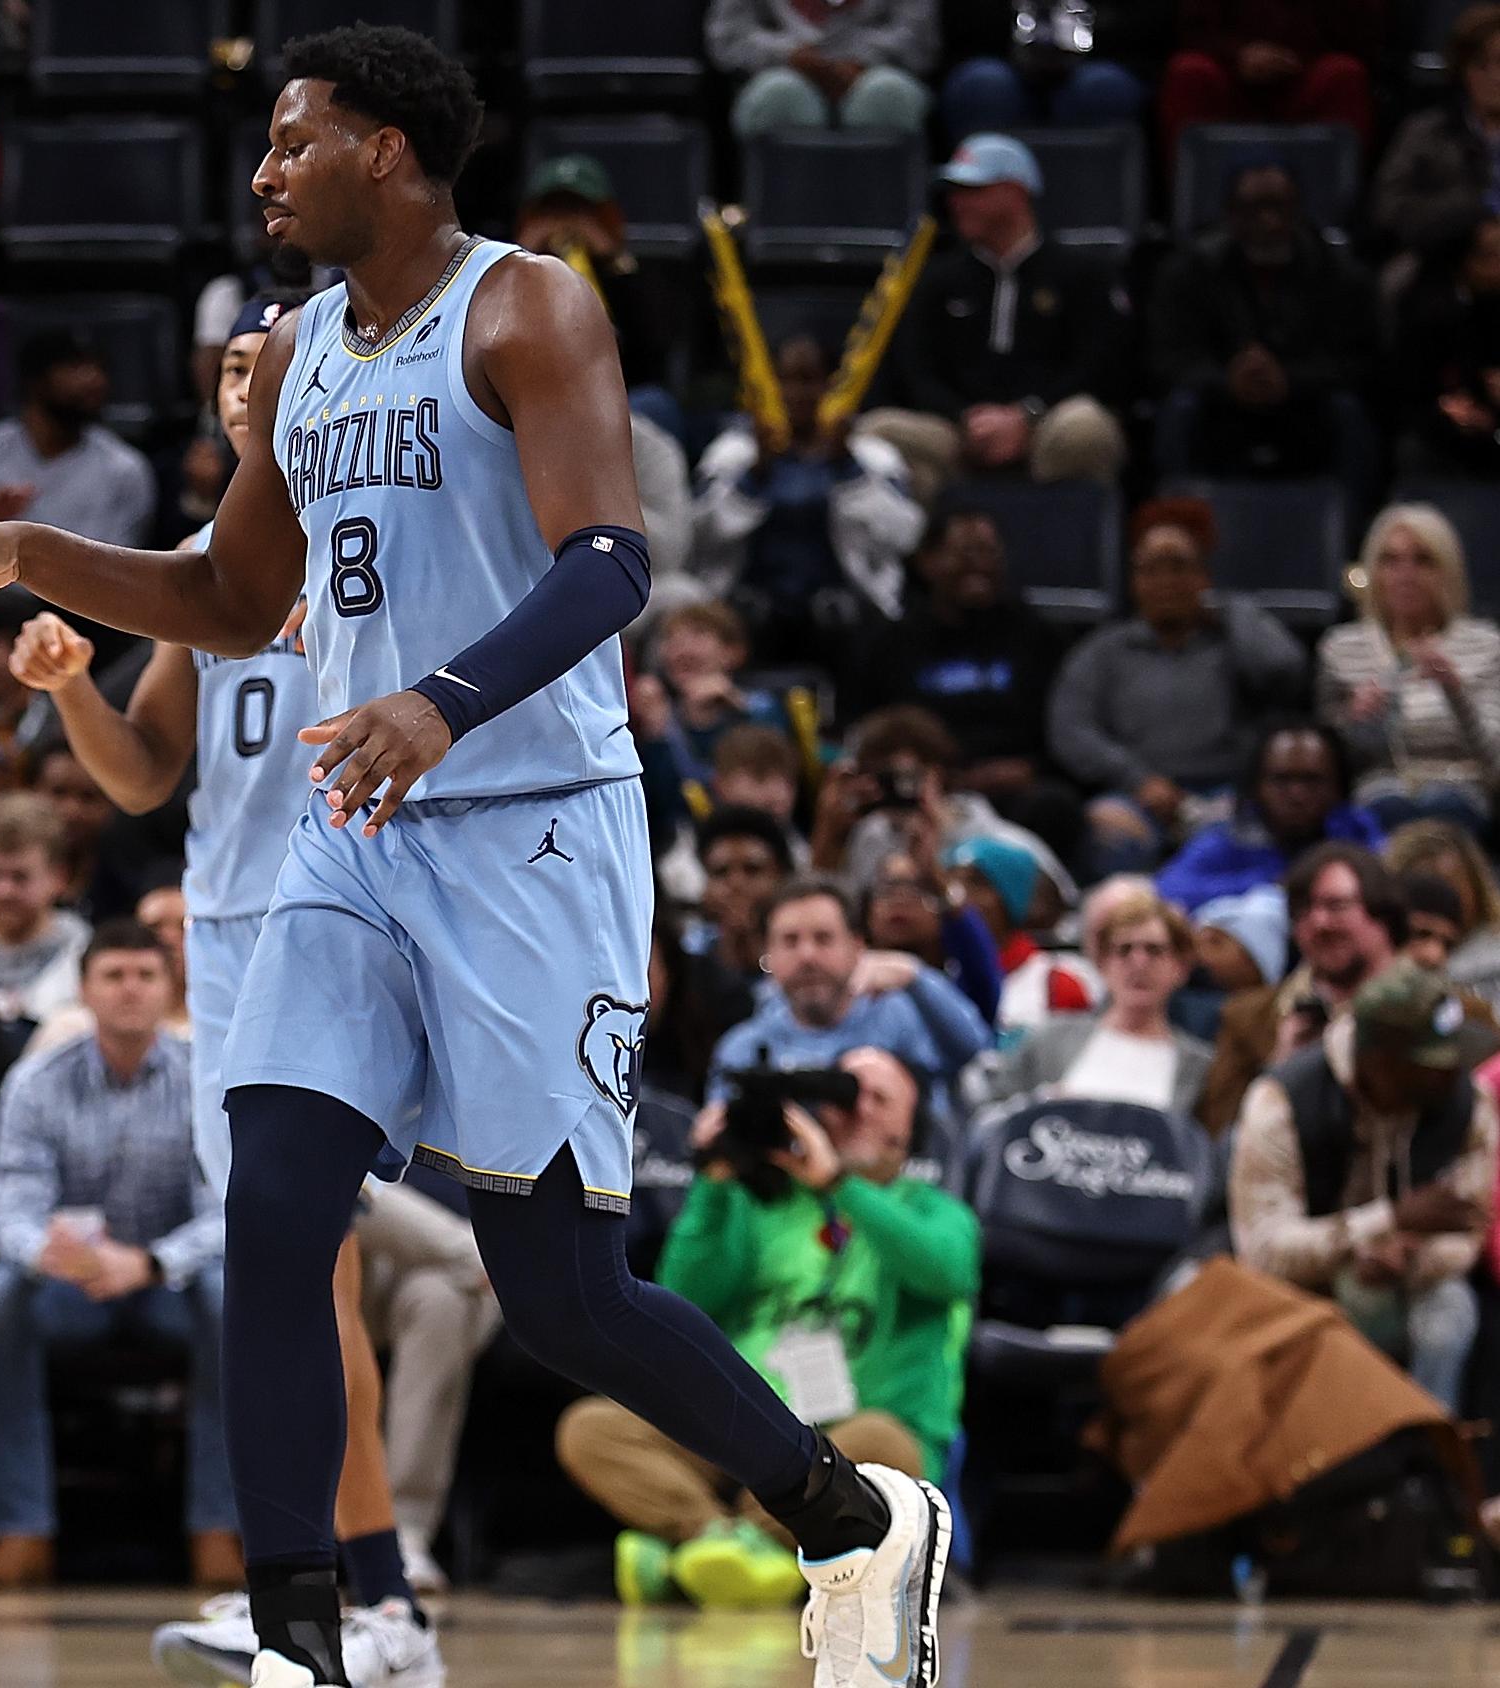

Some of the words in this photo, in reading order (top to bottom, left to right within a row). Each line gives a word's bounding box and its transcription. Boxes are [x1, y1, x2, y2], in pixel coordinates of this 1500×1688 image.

[395, 348, 440, 367] Robinhood
[288, 397, 443, 517] GRIZZLIES
[330, 515, 384, 618] 8
[235, 677, 274, 758] 0
